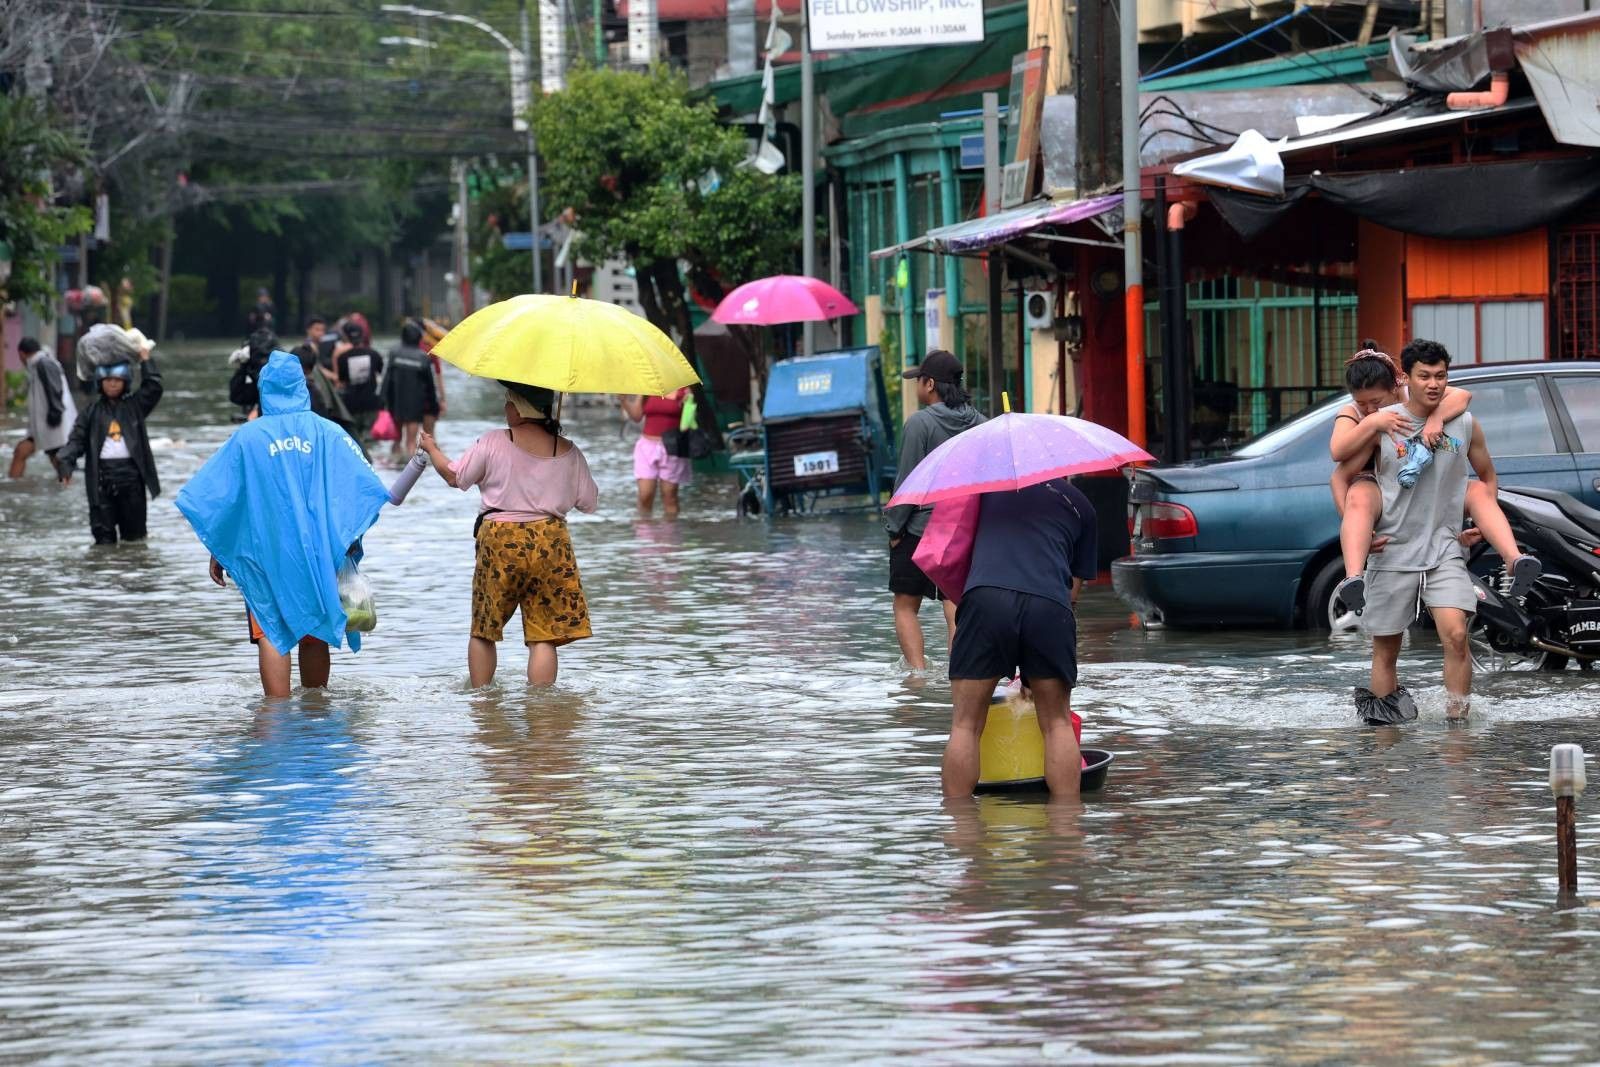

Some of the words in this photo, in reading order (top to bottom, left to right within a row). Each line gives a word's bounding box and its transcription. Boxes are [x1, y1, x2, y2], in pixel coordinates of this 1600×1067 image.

[813, 0, 934, 16] FELLOWSHIP,
[938, 0, 976, 8] INC.
[826, 30, 855, 41] Sunday
[858, 28, 887, 39] Service:
[889, 26, 922, 37] 9:30AM
[930, 24, 967, 35] 11:30AM
